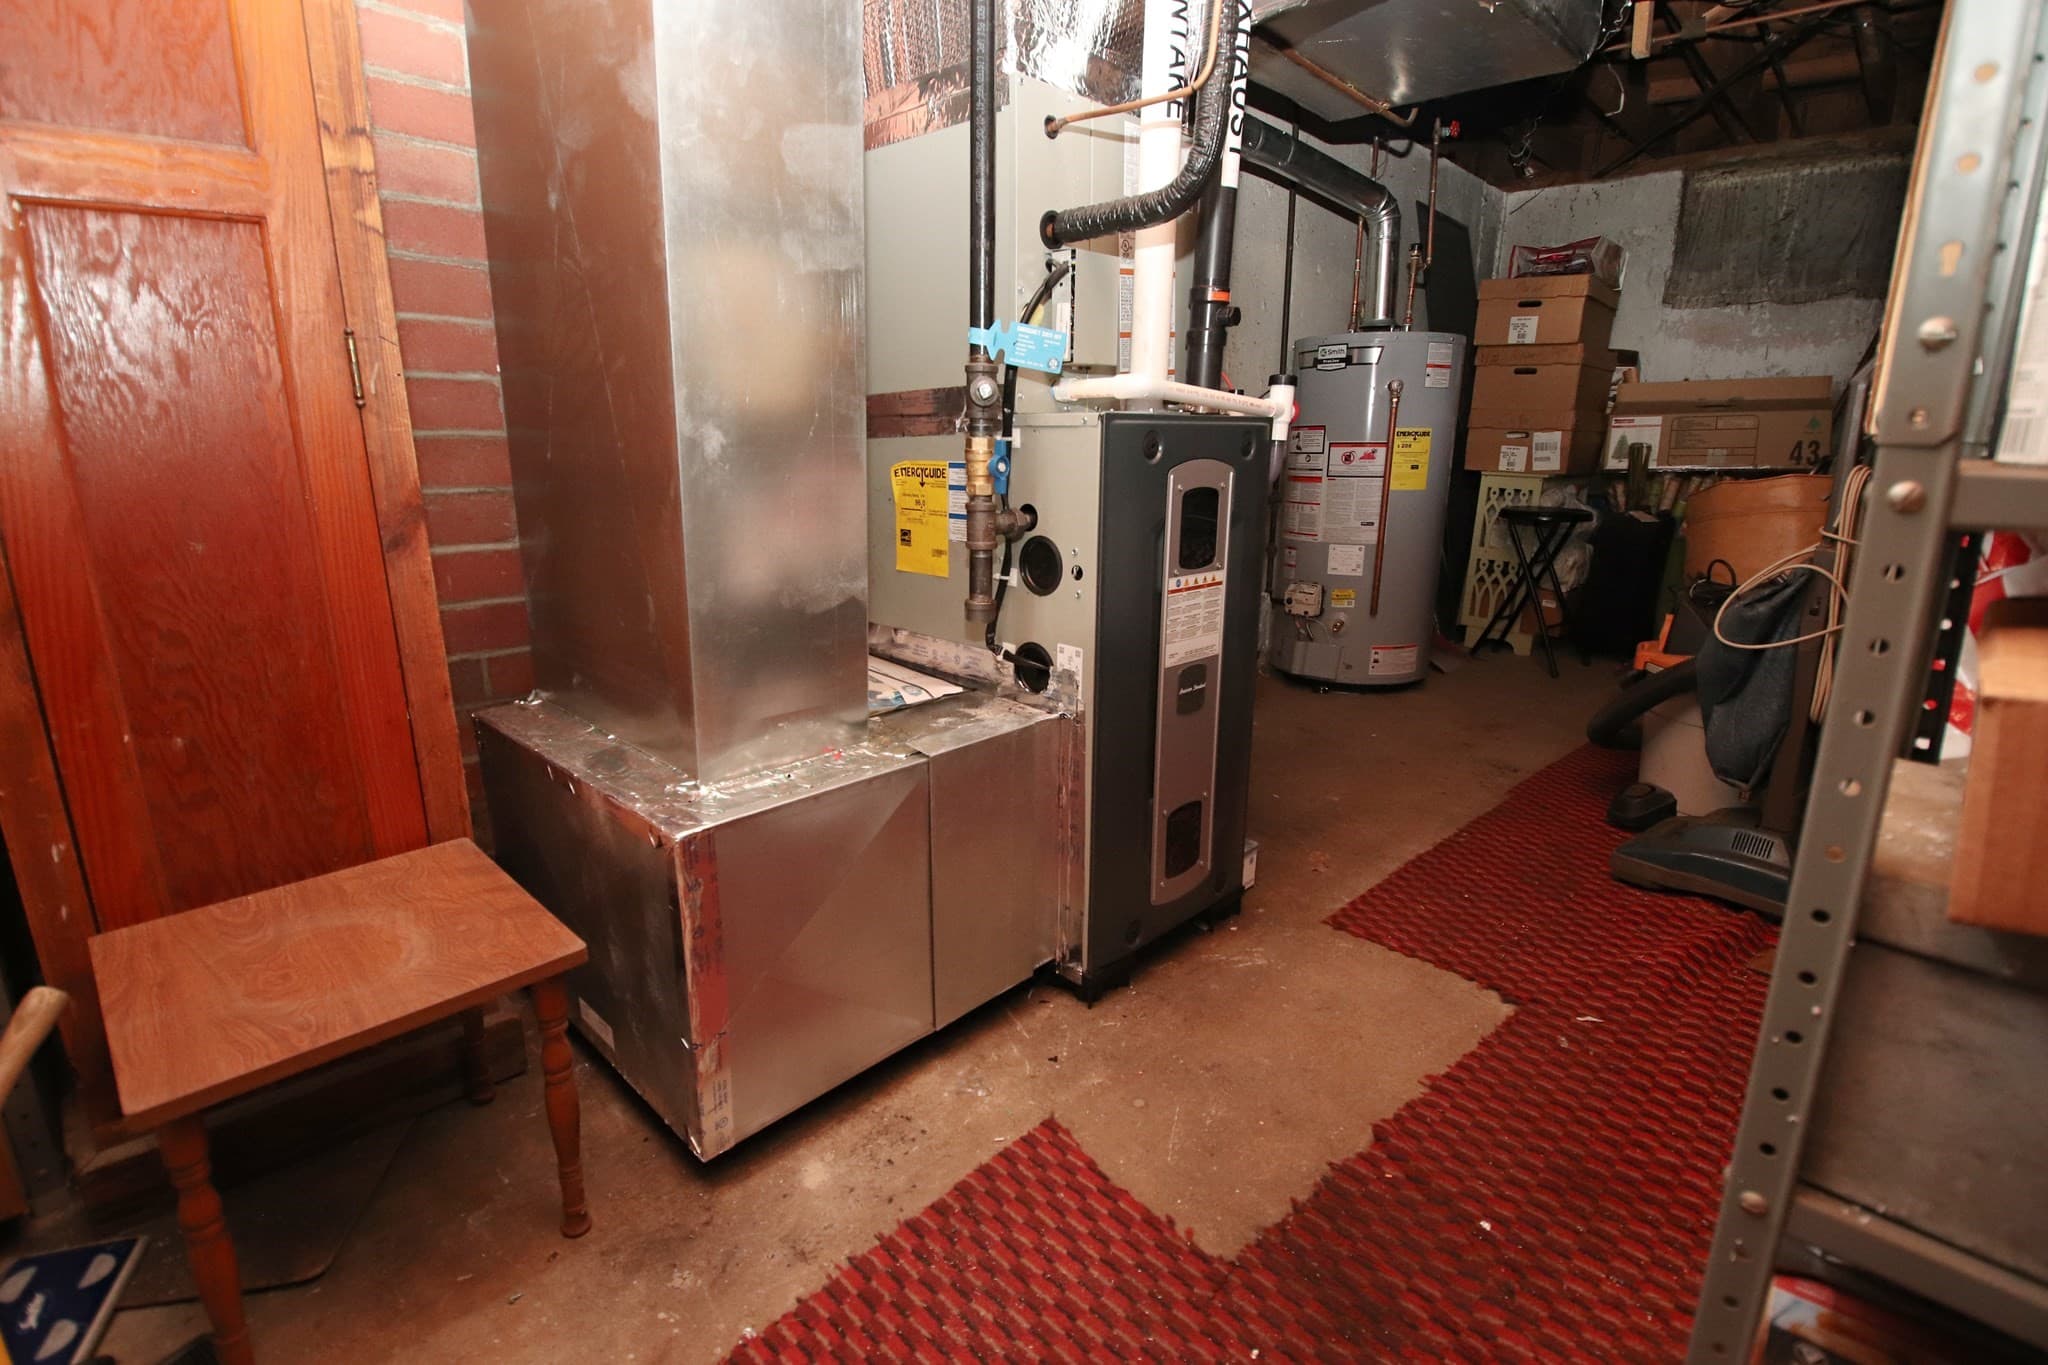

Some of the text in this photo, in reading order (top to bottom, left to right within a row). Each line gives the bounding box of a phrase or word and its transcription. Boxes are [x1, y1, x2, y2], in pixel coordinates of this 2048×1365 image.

[976, 55, 985, 83] LISTED
[1327, 347, 1345, 356] Smith
[1789, 440, 1821, 465] 43
[894, 466, 947, 479] ENERGYGUIDE
